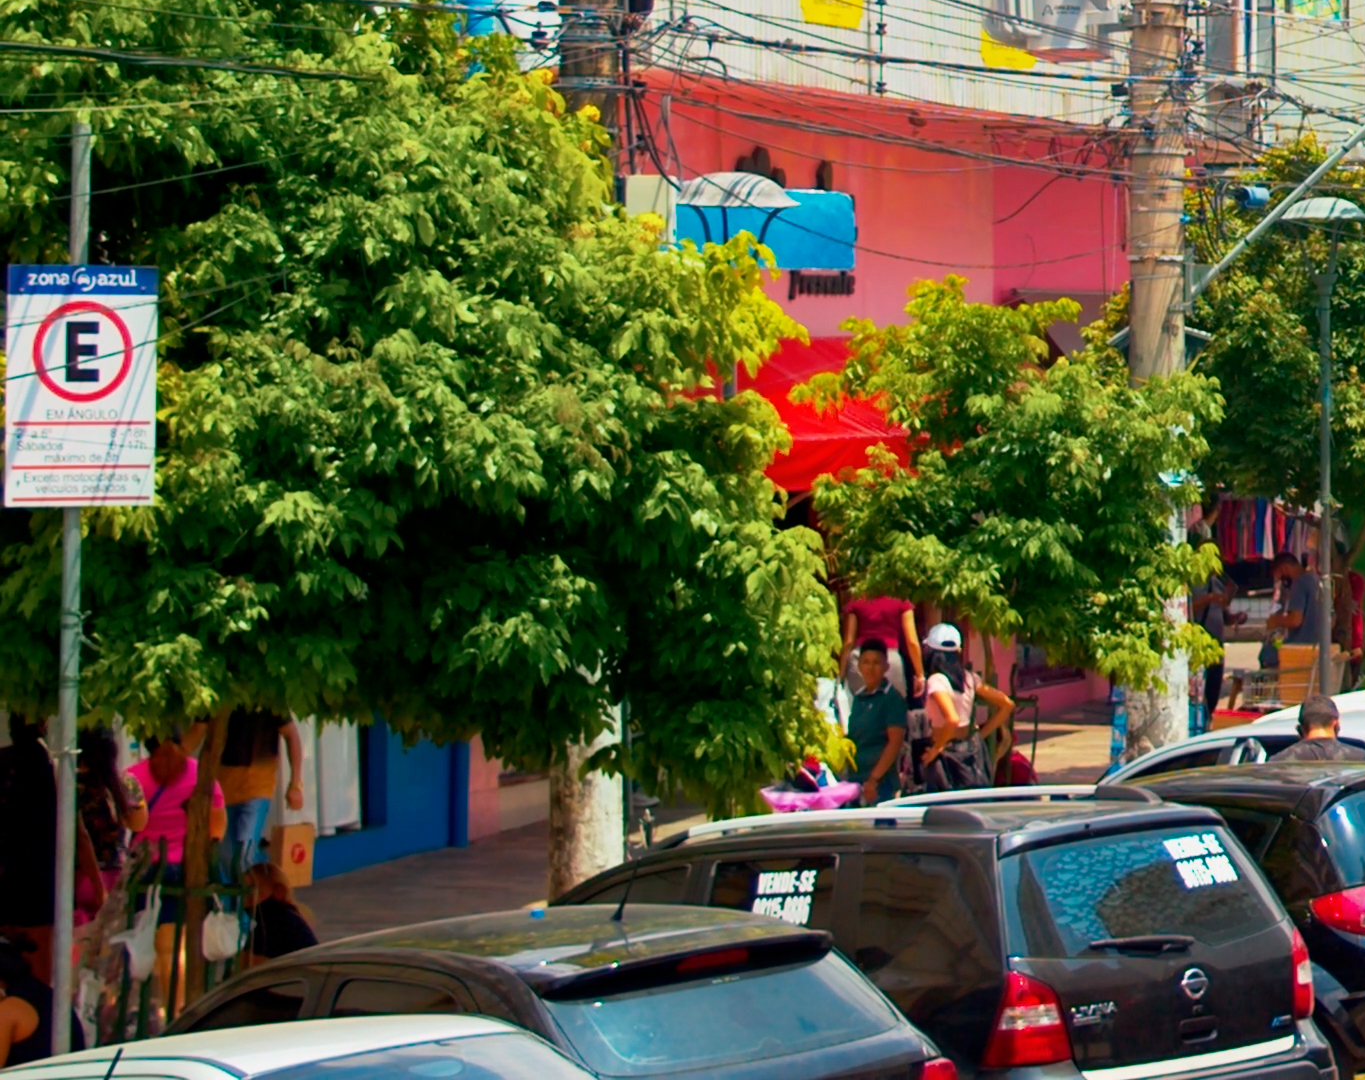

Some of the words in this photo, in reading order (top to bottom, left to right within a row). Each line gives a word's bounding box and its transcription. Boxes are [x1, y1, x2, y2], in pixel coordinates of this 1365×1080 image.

[27, 273, 70, 287] zona
[97, 269, 138, 287] azul
[65, 321, 100, 383] E
[46, 409, 64, 420] EM
[67, 407, 119, 420] ÂNGULO
[44, 452, 86, 463] máximo
[89, 453, 103, 463] de
[756, 869, 818, 895] VENDE-SE
